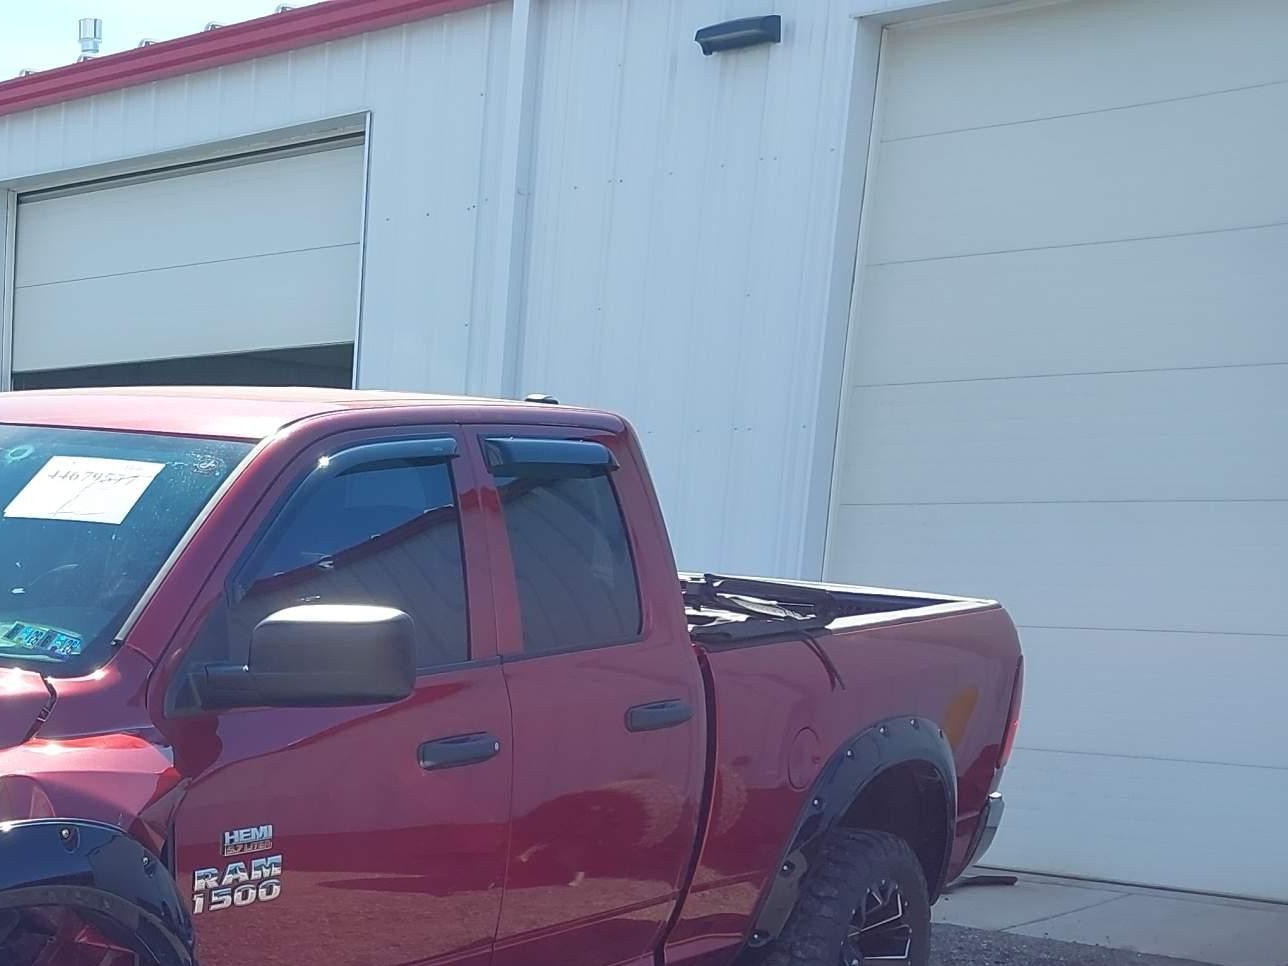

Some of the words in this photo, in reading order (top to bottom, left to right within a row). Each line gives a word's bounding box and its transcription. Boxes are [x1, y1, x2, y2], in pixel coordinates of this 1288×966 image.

[224, 824, 273, 845] HEMI
[193, 854, 283, 892] RAM
[193, 878, 282, 915] 1500
